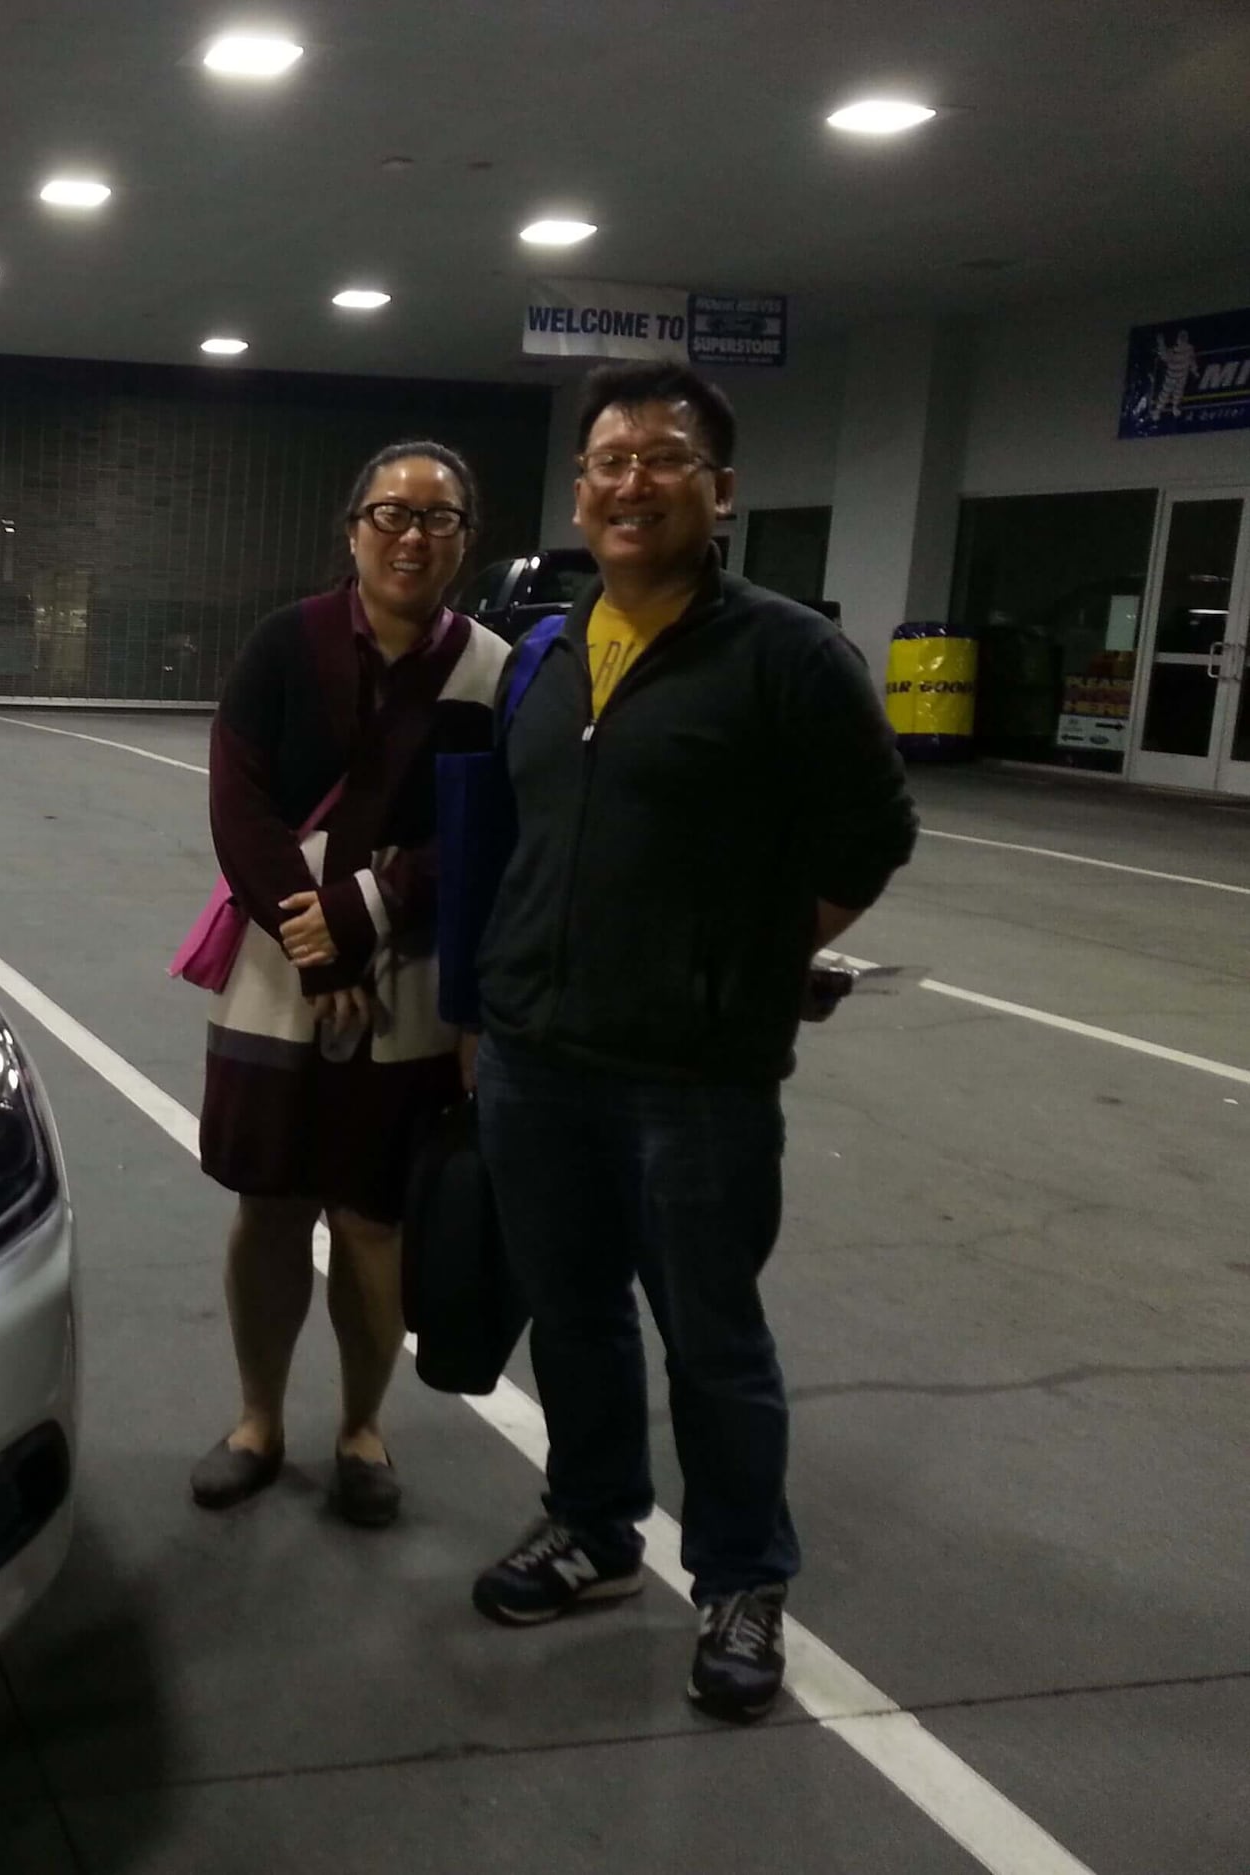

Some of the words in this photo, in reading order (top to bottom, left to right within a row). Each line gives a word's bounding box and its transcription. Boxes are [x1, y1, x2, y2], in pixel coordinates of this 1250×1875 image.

[528, 305, 650, 339] WELCOME
[656, 314, 684, 341] TO
[693, 335, 782, 355] SUPERSTORE
